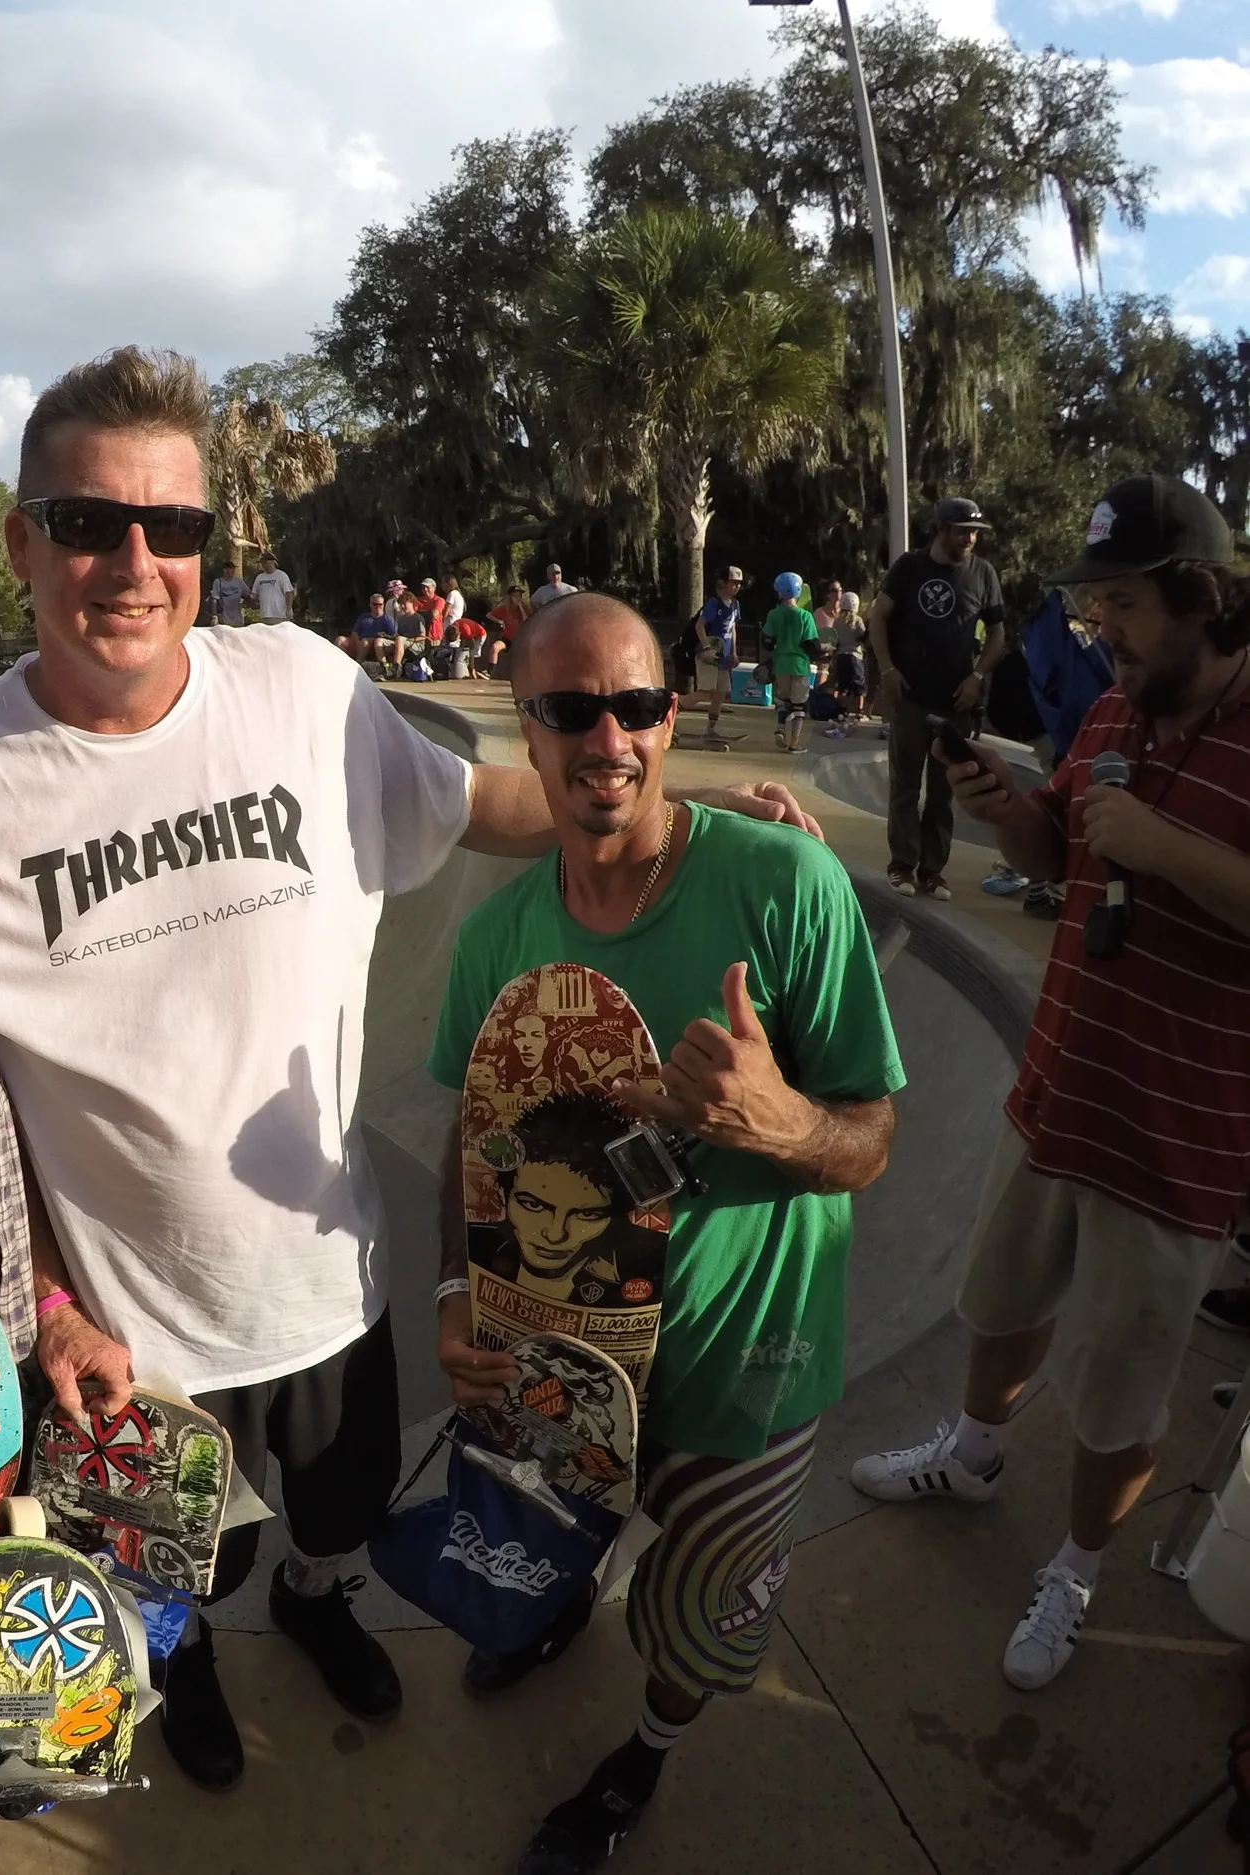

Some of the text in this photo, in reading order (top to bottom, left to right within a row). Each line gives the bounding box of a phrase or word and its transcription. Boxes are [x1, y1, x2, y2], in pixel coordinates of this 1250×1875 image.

[19, 783, 313, 950] THRASHER
[49, 880, 317, 967] SKATEBOARD MAGAZINE
[480, 1278, 519, 1314] NEWS
[518, 1295, 578, 1323] WORLD
[478, 1318, 519, 1342] Jello Bia
[517, 1308, 577, 1334] ORDER
[476, 1326, 513, 1352] MON
[583, 1332, 620, 1342] QUESTION
[619, 1361, 645, 1380] HE
[534, 1394, 566, 1418] RUZ
[449, 1510, 559, 1590] Marinela
